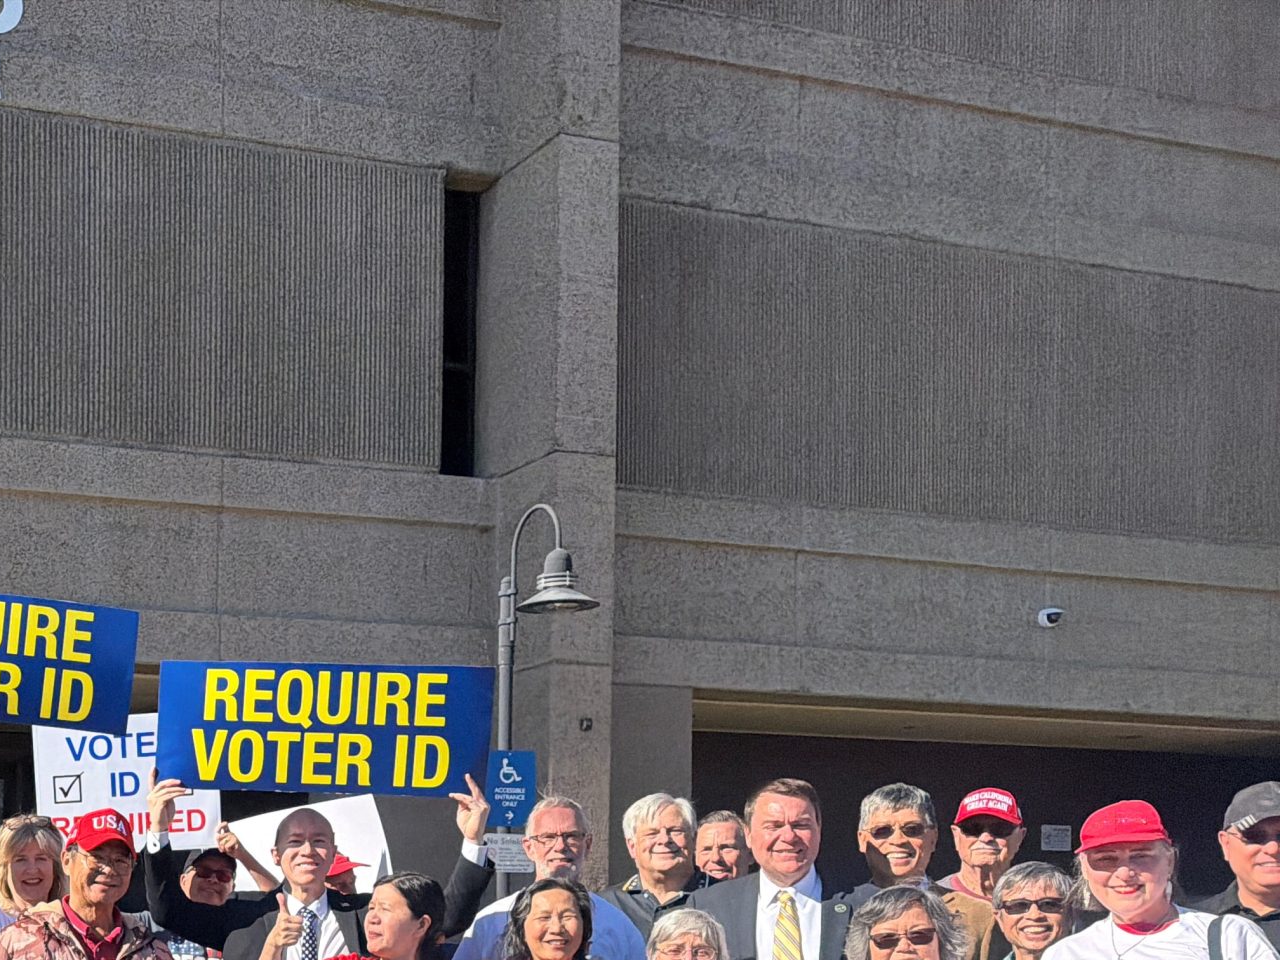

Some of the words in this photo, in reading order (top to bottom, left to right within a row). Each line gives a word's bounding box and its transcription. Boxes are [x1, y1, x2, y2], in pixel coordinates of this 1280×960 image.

[39, 668, 94, 722] ID
[203, 669, 448, 728] REQUIRE
[66, 732, 156, 761] VOTE
[192, 728, 372, 786] VOTER
[394, 735, 450, 788] ID
[110, 772, 140, 797] ID
[92, 814, 127, 836] USA
